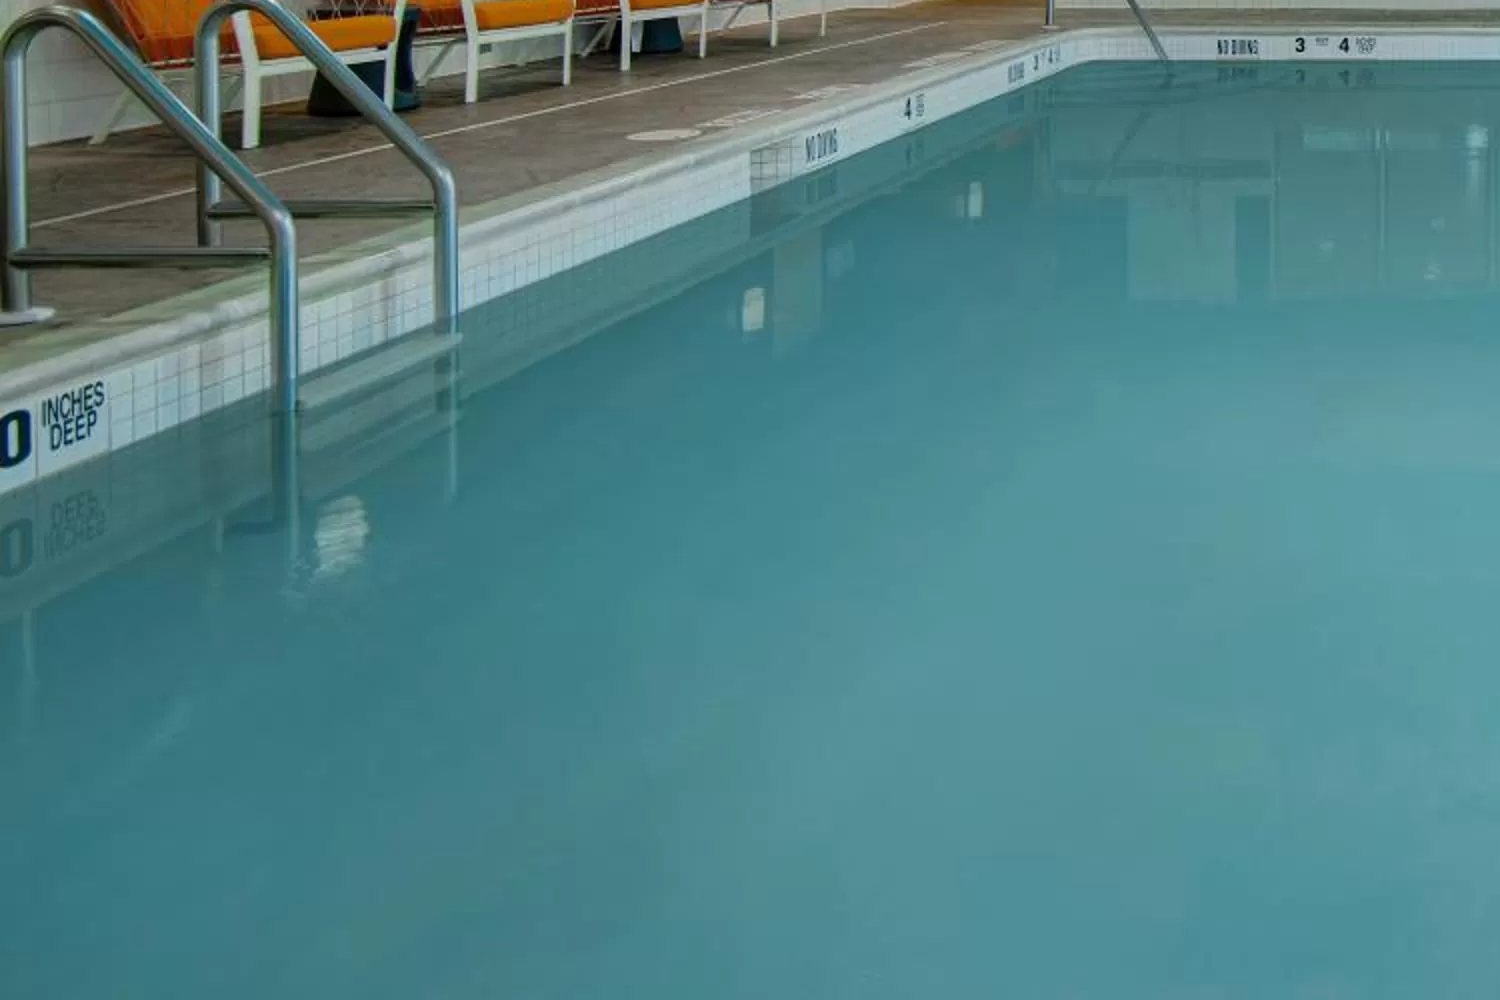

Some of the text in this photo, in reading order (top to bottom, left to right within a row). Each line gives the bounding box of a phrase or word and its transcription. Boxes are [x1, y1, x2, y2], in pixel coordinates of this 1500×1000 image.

[1295, 37, 1305, 53] 3
[1339, 37, 1350, 54] 4
[903, 96, 912, 120] 4
[0, 380, 104, 468] 0 INCHES
[51, 409, 98, 450] DEEP
